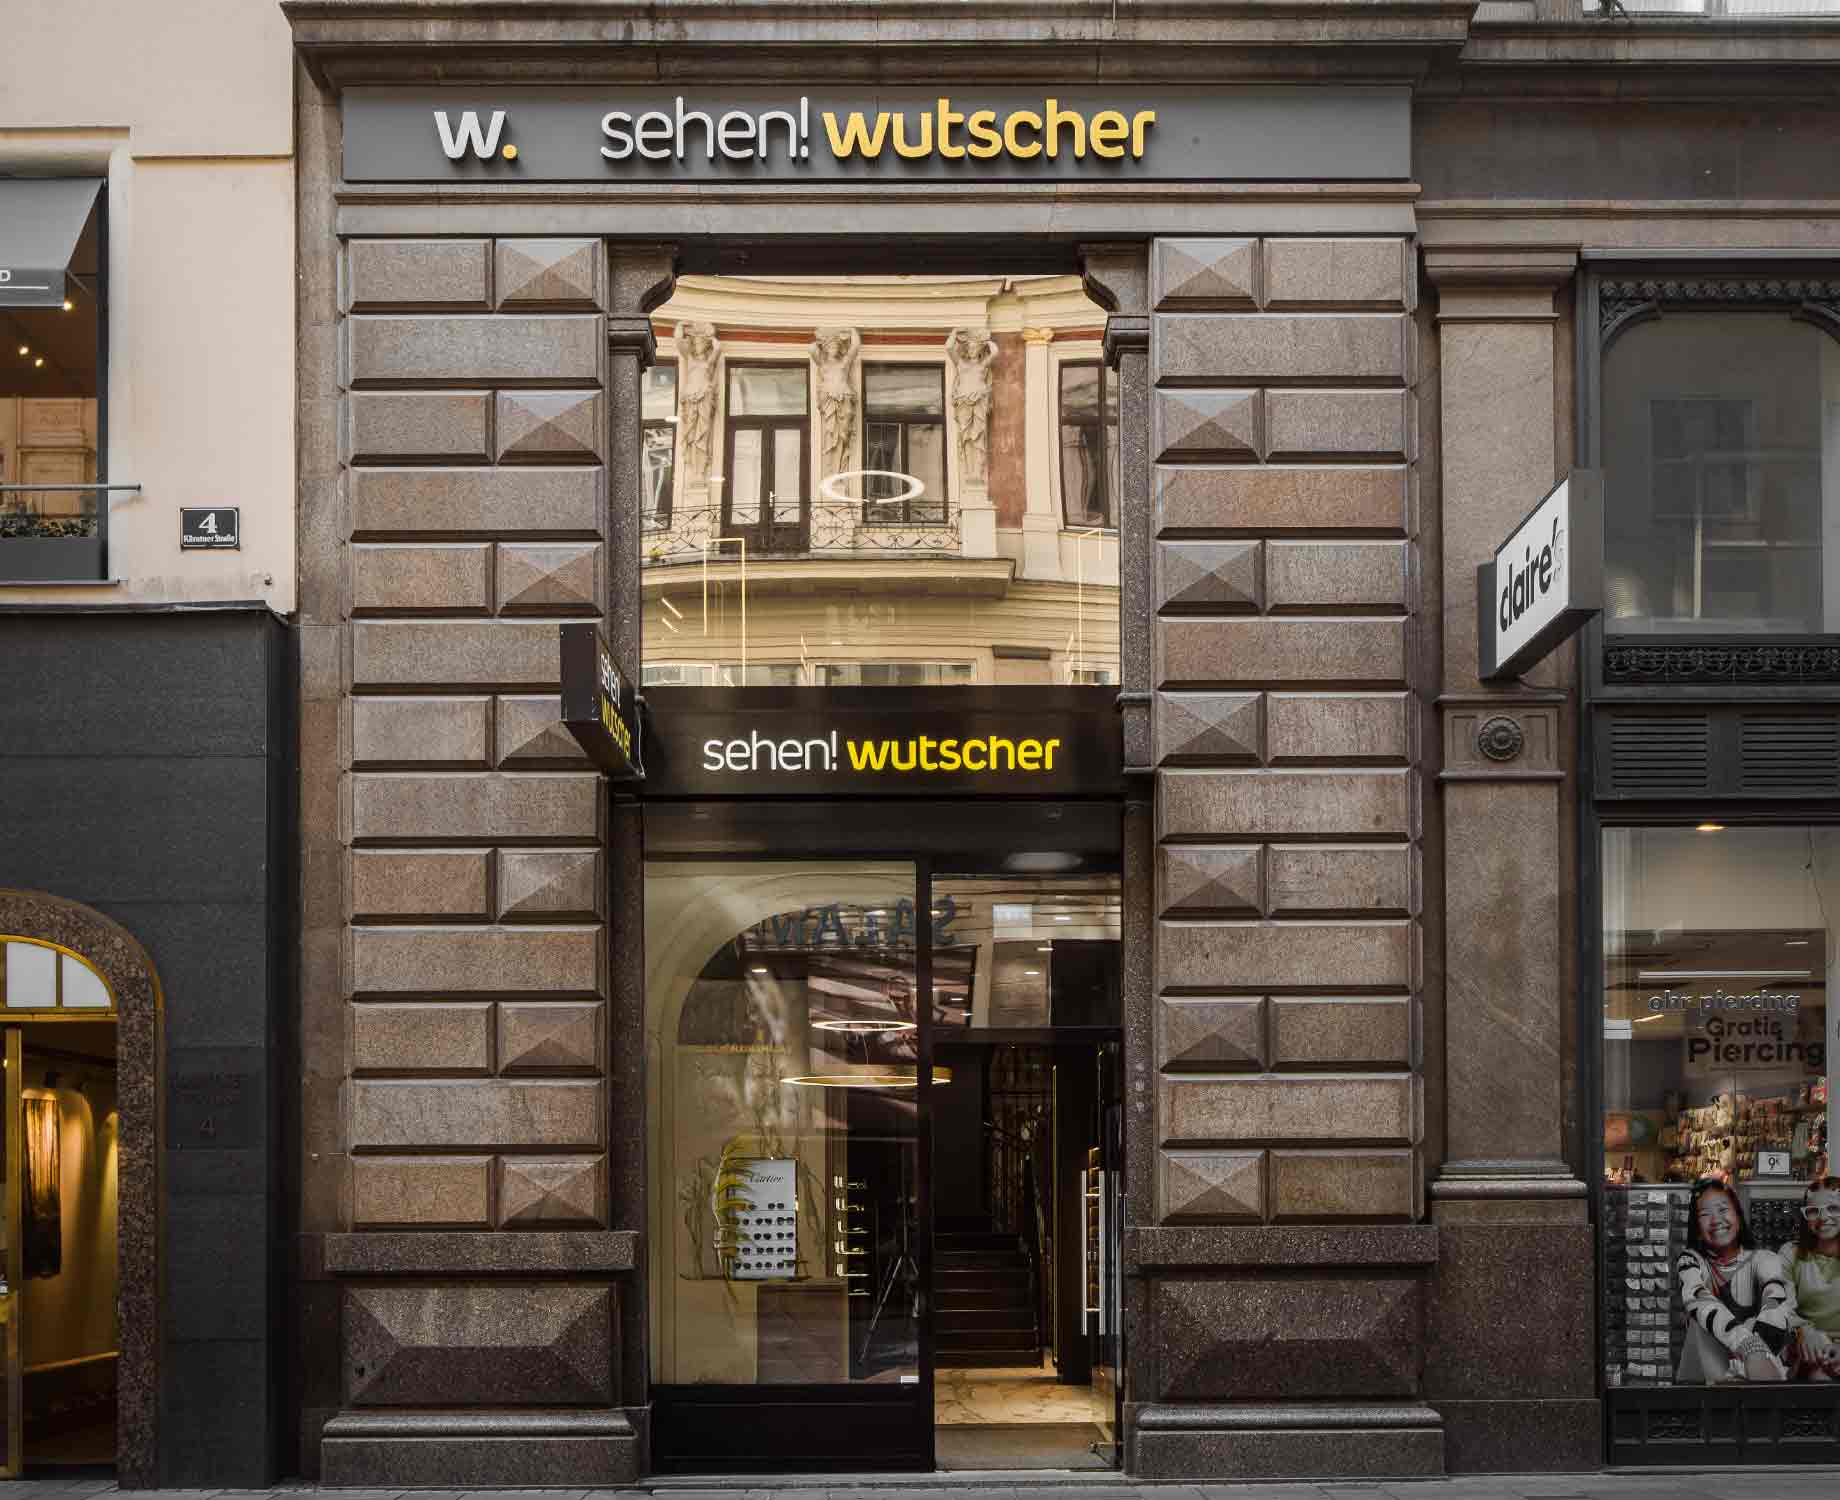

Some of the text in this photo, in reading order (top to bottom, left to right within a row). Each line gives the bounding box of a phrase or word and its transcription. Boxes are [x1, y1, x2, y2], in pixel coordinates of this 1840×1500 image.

[434, 111, 517, 158] w.
[600, 97, 1156, 158] sehen! wutscher
[198, 512, 218, 534] 4
[703, 730, 1061, 771] sehen! wutscher
[1648, 989, 1801, 1016] ohr piercing
[1688, 1038, 1825, 1066] Piercing
